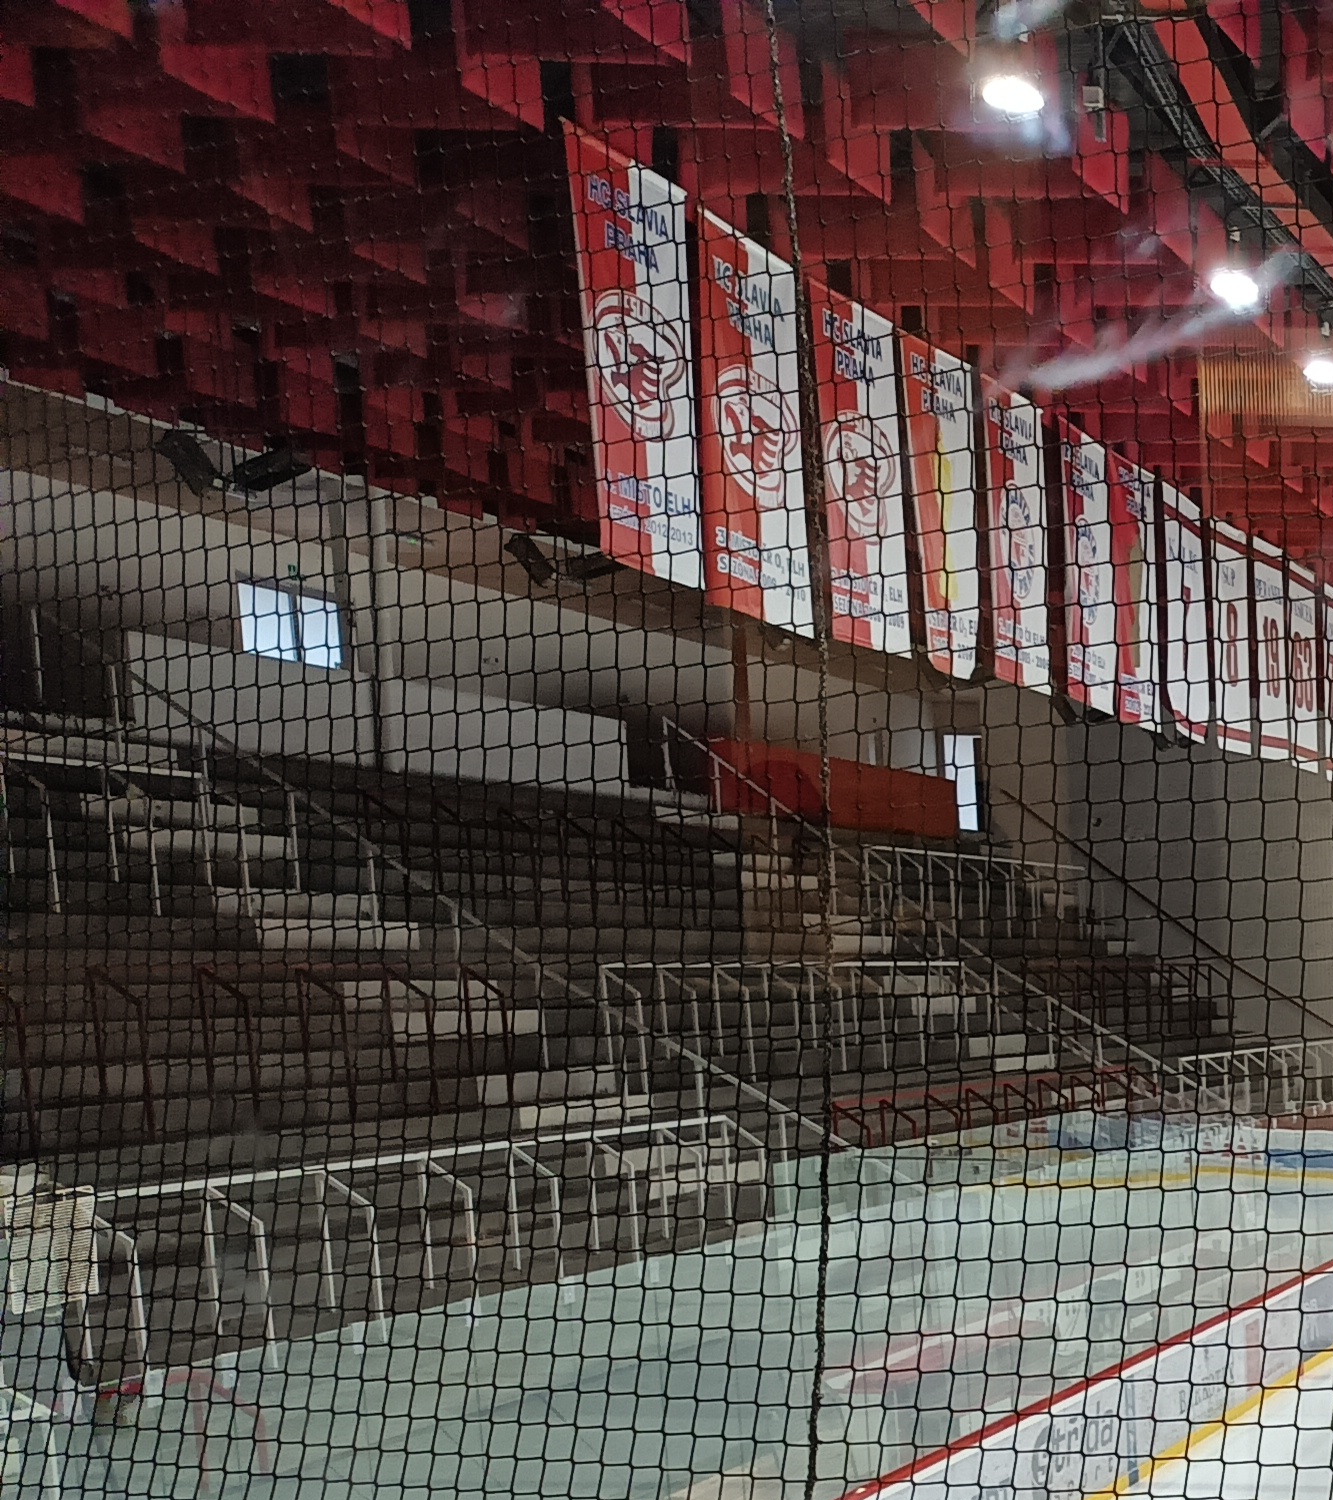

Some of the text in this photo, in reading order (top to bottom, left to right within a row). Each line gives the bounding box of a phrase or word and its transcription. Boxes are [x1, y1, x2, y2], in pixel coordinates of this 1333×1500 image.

[604, 220, 660, 274] PRAHA
[1227, 602, 1239, 688] 8
[1263, 615, 1281, 698] 19
[1294, 630, 1314, 713] 63
